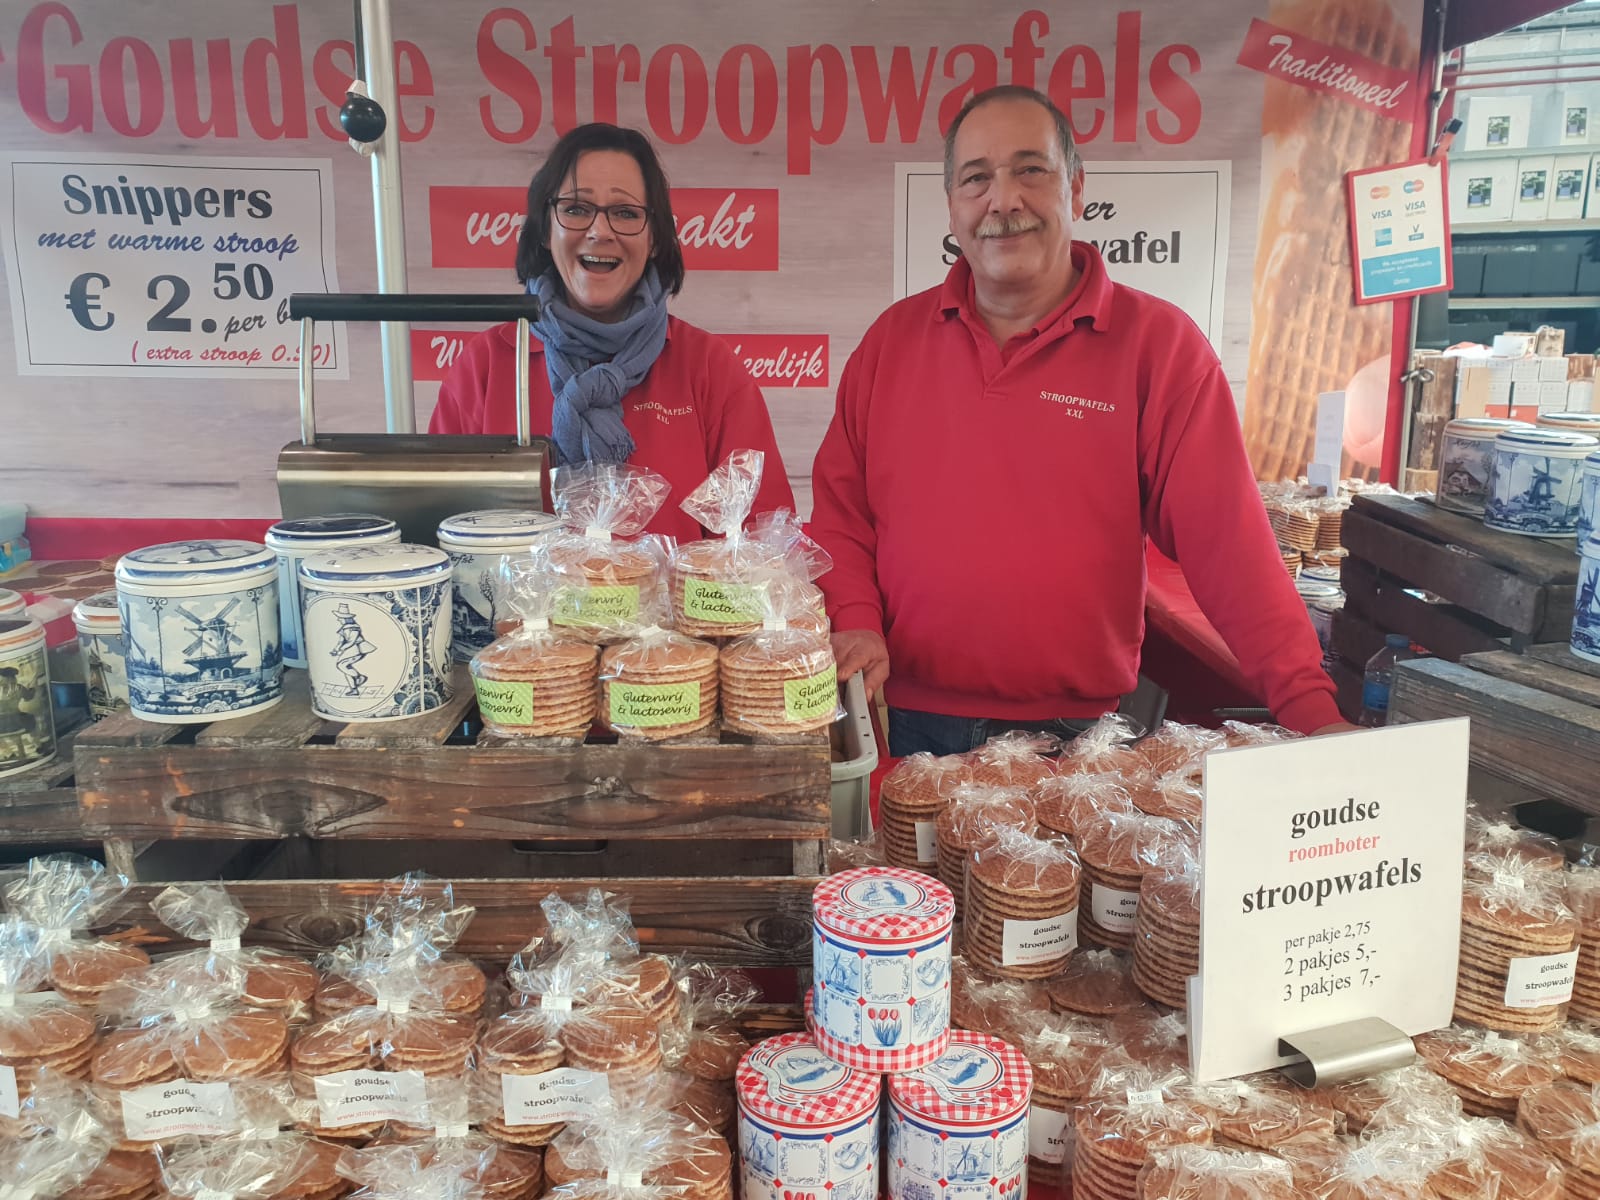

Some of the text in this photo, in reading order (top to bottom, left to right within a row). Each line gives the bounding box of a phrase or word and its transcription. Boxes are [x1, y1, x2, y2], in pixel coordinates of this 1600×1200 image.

[1268, 34, 1408, 109] Traditioneel
[62, 174, 273, 225] Snippers
[1405, 201, 1426, 211] VISA
[1371, 210, 1393, 219] VISA
[38, 229, 299, 260] met warme stroop
[65, 272, 115, 331] €
[225, 314, 267, 342] per
[147, 345, 192, 361] extra
[200, 347, 262, 365] stroop
[734, 344, 824, 389] eerlijk
[1040, 391, 1116, 412] STROOPWAFELS
[1066, 408, 1084, 419] XXL
[479, 687, 518, 704] tenvrij
[622, 691, 685, 706] Glutenvrij
[617, 702, 693, 718] & lactosevrij
[1290, 799, 1381, 838] goudse
[1288, 834, 1381, 863] roomboter
[1242, 858, 1423, 914] stroopwafels
[1105, 909, 1136, 919] stroop
[1019, 933, 1070, 949] stroopwafels
[1033, 924, 1061, 936] goudse
[1285, 921, 1371, 953] per pakje 2,75
[1284, 943, 1377, 976] 2 pakjes 5,-
[1540, 962, 1568, 973] goudse
[1283, 968, 1381, 1002] 3 pakjes 7,-
